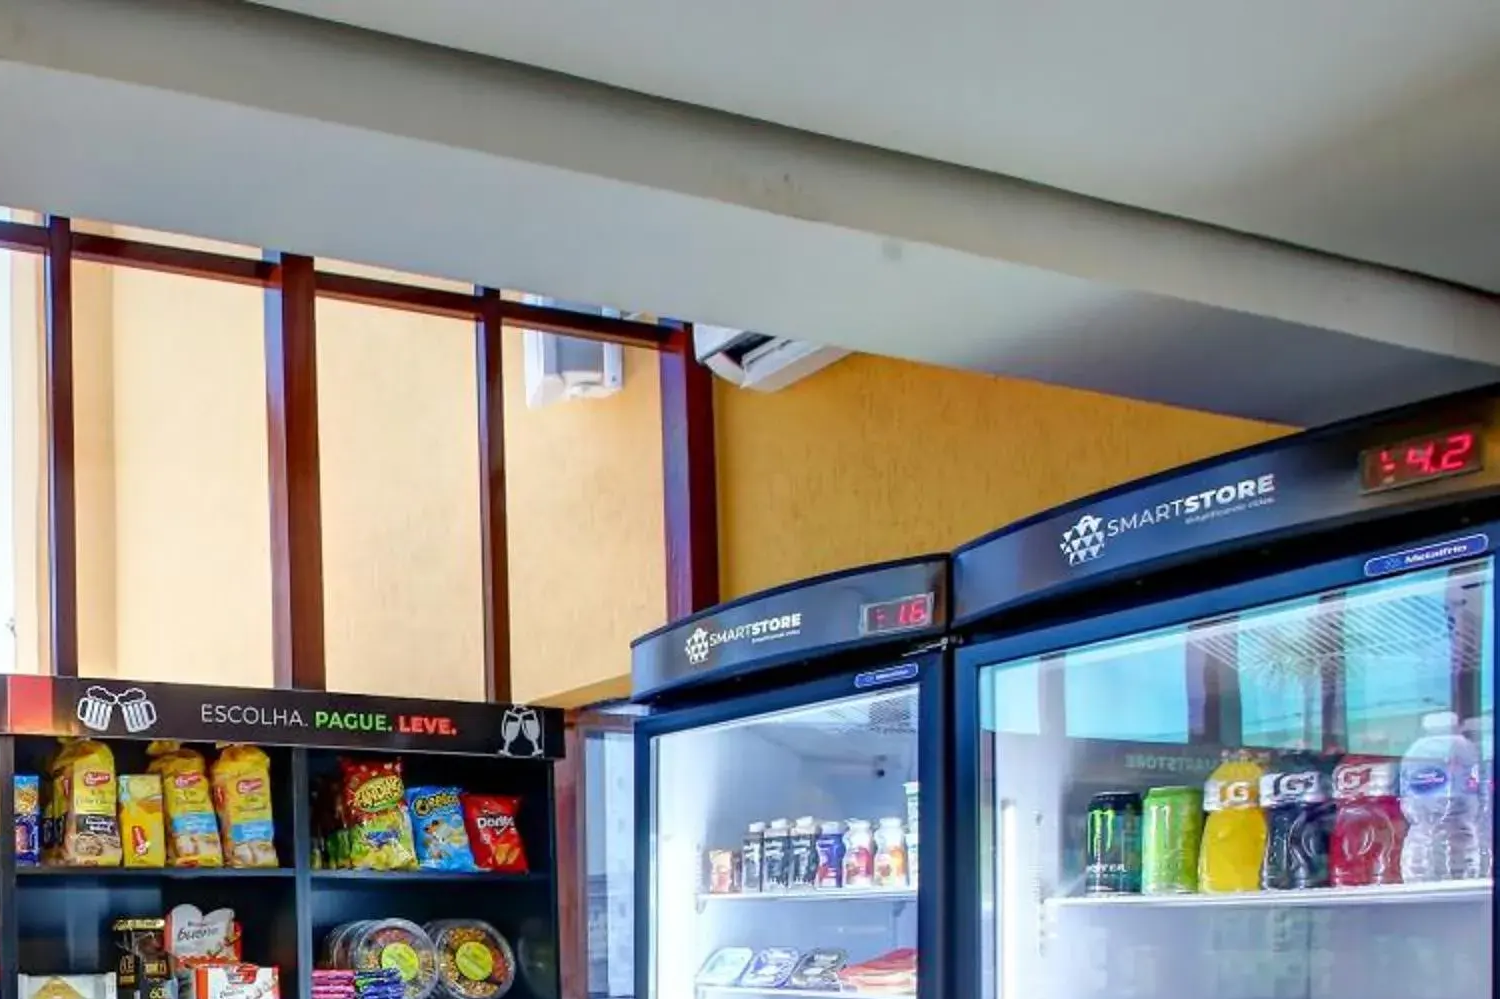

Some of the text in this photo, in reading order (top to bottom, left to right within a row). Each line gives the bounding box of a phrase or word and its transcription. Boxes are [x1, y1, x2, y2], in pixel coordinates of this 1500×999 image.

[1106, 473, 1276, 537] SMARTSTORE
[708, 613, 802, 647] SMARTSTORE
[200, 703, 458, 737] ESCOLHA. PAGUE. LEVE.
